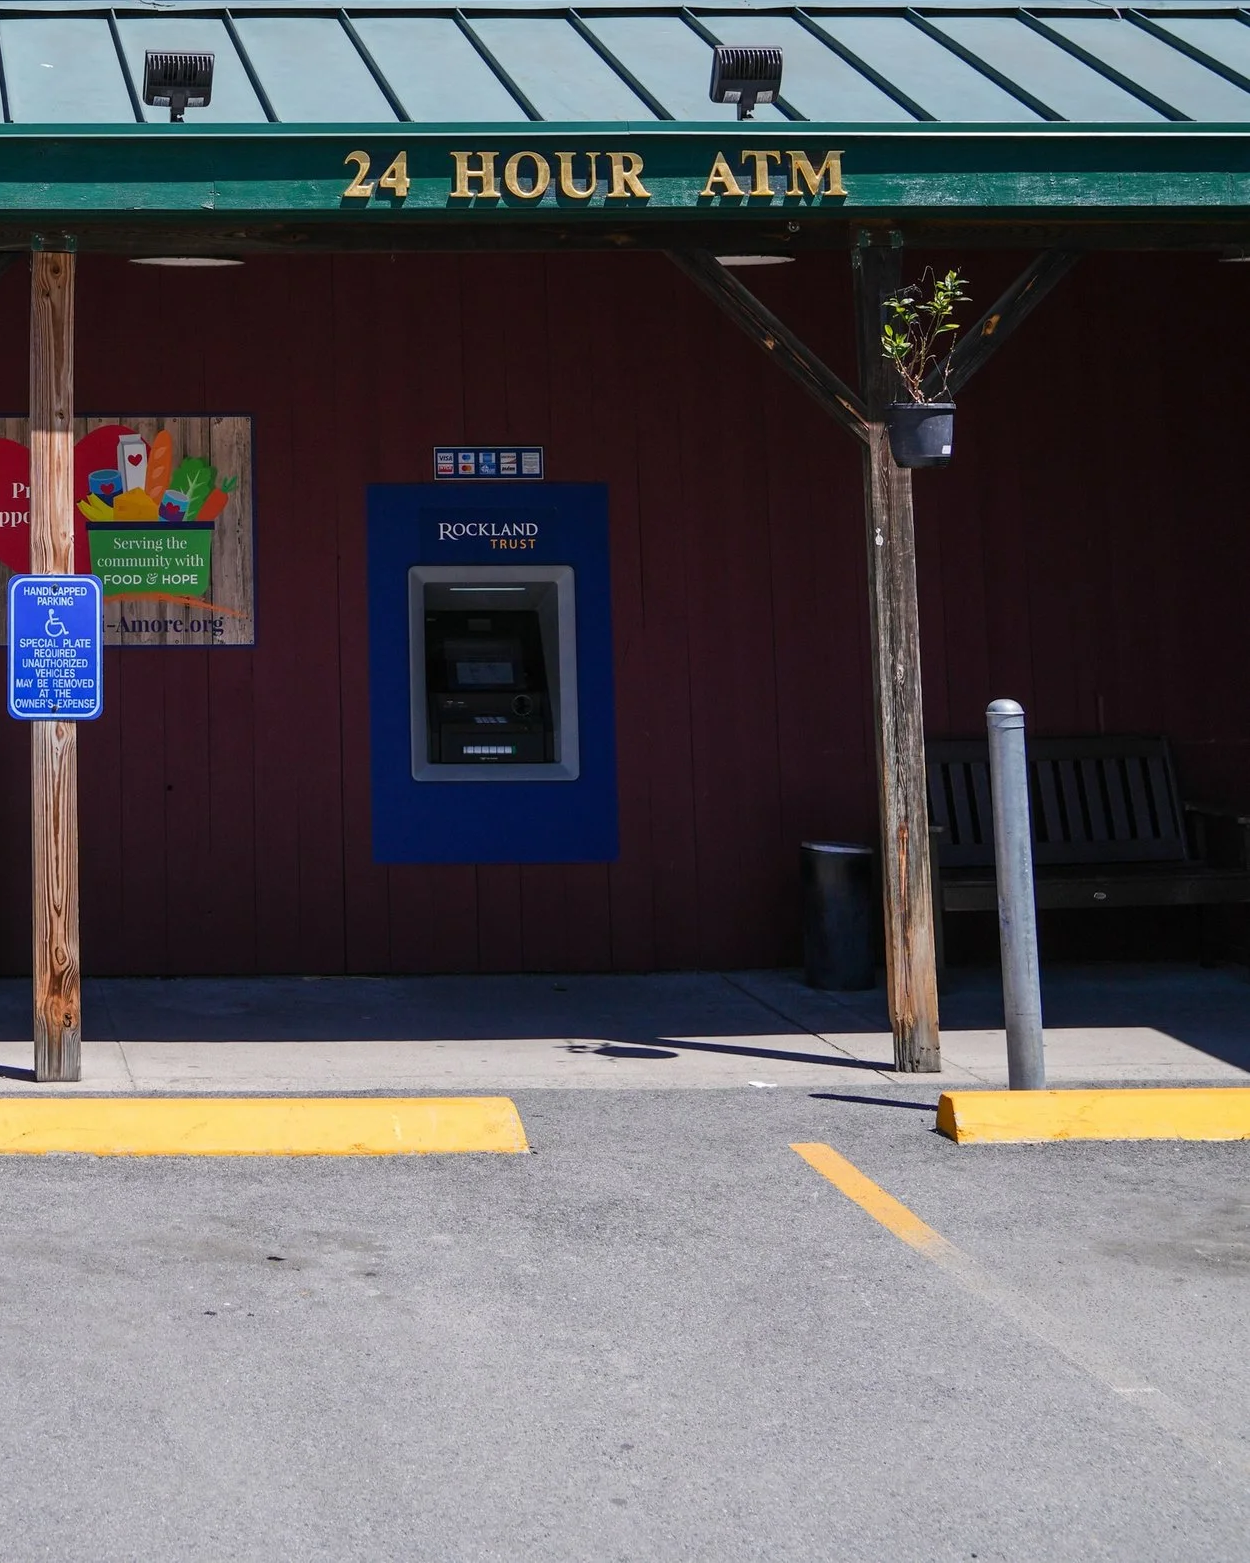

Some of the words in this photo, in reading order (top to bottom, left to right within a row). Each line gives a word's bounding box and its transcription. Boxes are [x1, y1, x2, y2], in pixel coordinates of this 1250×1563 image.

[343, 150, 410, 198] 24
[450, 151, 651, 198] HOUR
[701, 150, 848, 197] ATM
[438, 522, 538, 540] ROCKLAND
[113, 537, 163, 552] Serving
[166, 537, 187, 549] the
[490, 539, 536, 549] TRUST
[97, 555, 172, 569] community
[175, 554, 204, 567] with
[103, 574, 142, 585] FOOD
[146, 573, 158, 585] &
[162, 574, 198, 585] HOPE
[23, 587, 87, 596] HANDICAPPED
[37, 597, 74, 606] PARKING
[103, 616, 224, 636] -Amore.org
[19, 638, 58, 648] SPECIAL
[62, 638, 91, 648] PLATE
[34, 648, 77, 658] REQUIRED
[22, 658, 88, 668] UNAUTHORIZED
[35, 668, 76, 678] VEHICLES
[16, 678, 33, 688] MAY
[37, 678, 48, 688] BE
[52, 678, 94, 688] REMOVED
[39, 688, 50, 698] AT
[53, 688, 71, 698] THE
[15, 698, 54, 709] OWNER'S
[57, 698, 95, 709] EXPENSE
